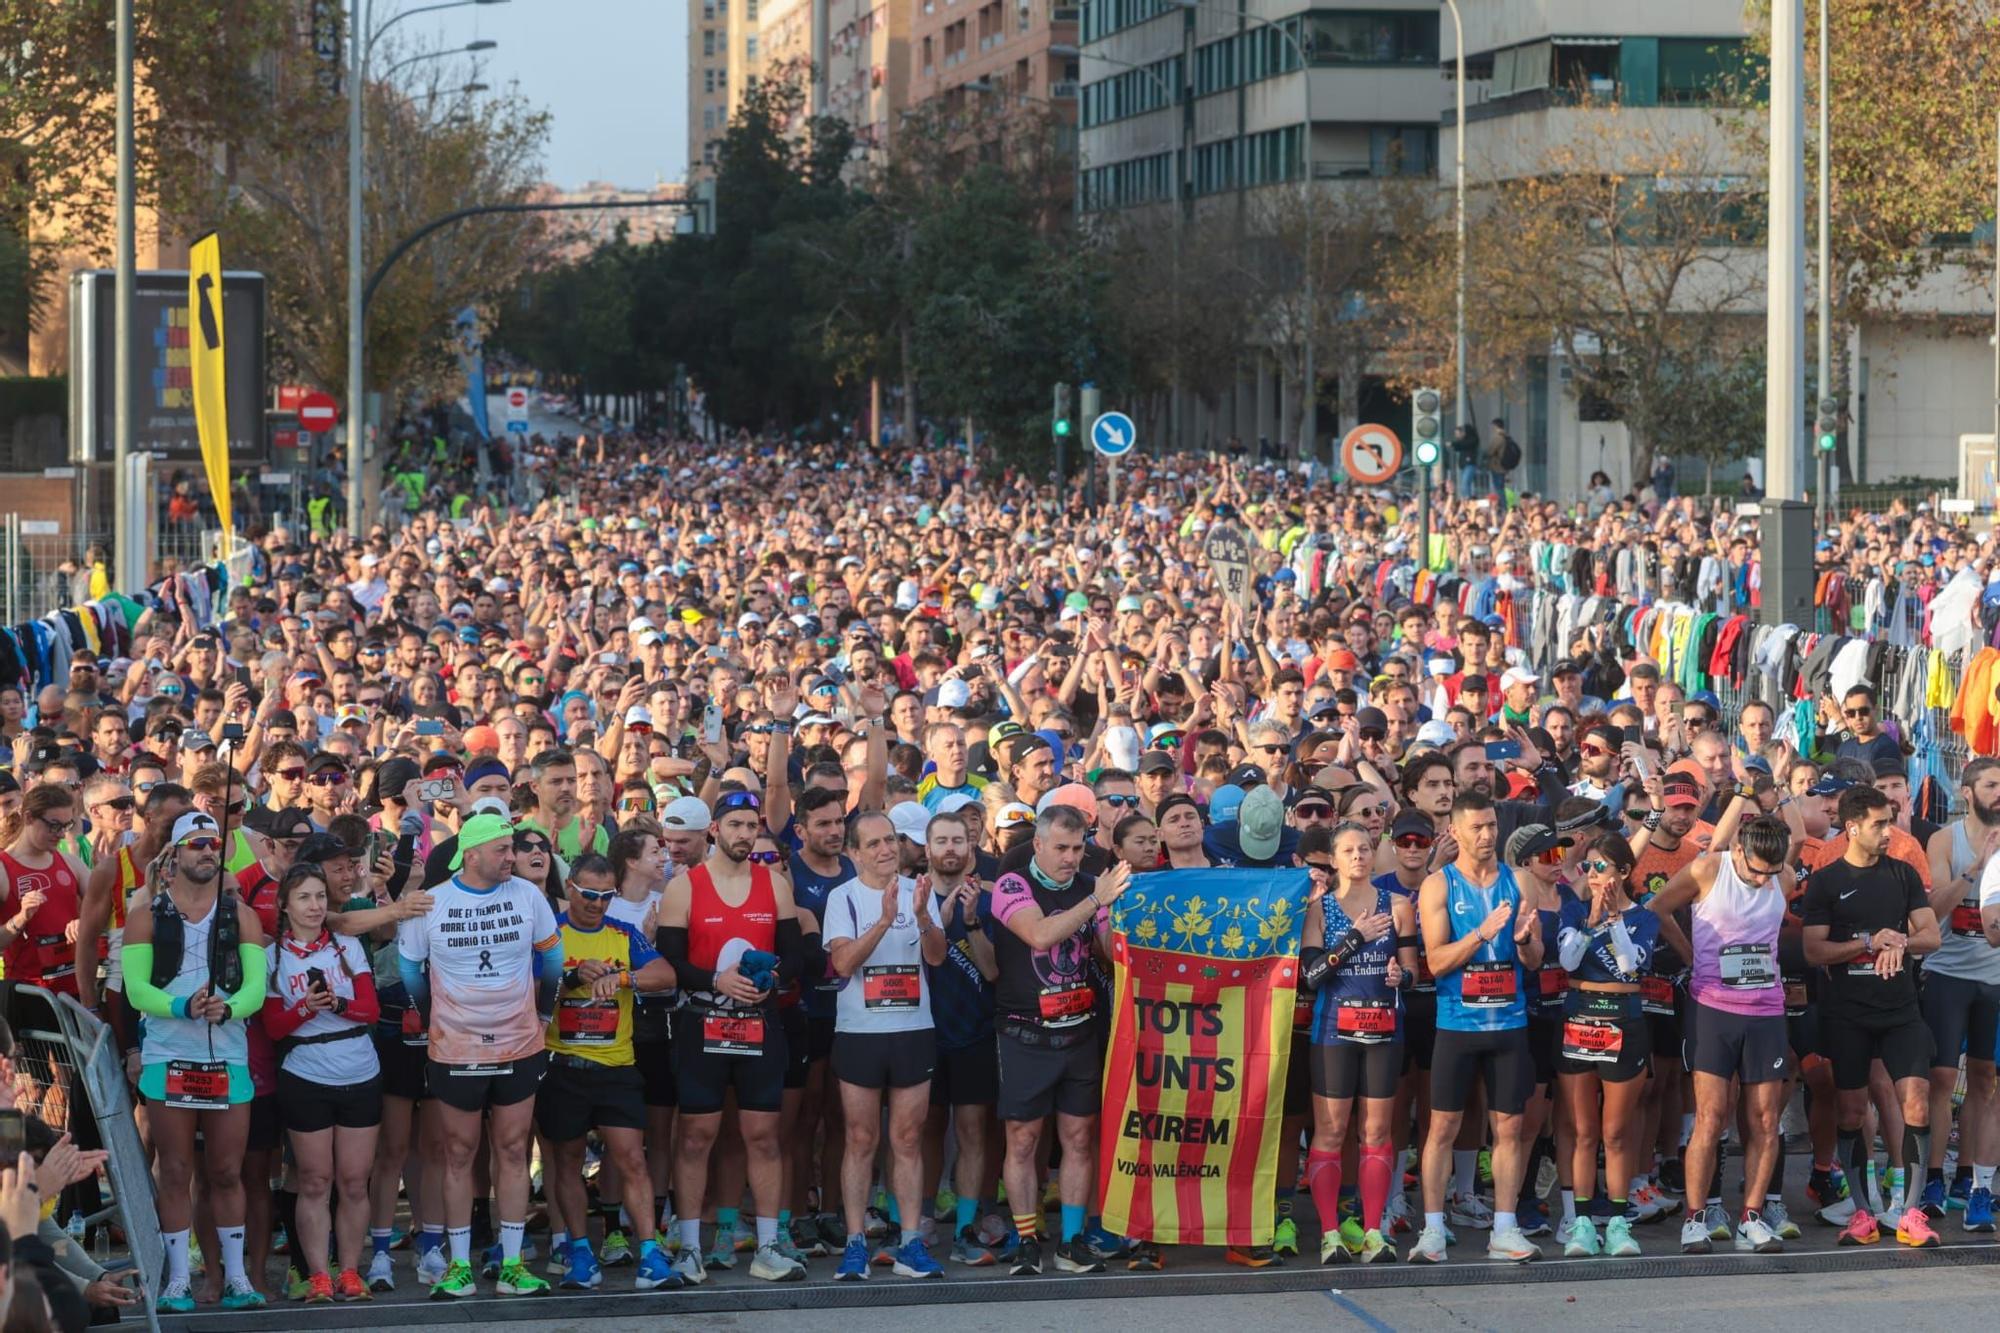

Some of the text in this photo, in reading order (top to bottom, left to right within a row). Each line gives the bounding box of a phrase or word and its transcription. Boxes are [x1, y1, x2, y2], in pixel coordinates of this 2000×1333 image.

[448, 908, 463, 919] QUE
[475, 903, 502, 918] TIEMPO
[503, 901, 514, 911] NO
[440, 922, 466, 933] BORRE
[468, 921, 479, 932] LO
[480, 920, 497, 931] QUE
[498, 917, 510, 928] UN
[481, 936, 491, 945] EL
[493, 931, 520, 944] BARRO
[1133, 997, 1223, 1036] TOTS
[1136, 1051, 1235, 1092] UNTS
[1123, 1110, 1230, 1145] EXIREM
[1153, 1161, 1220, 1177] VALÈNCIA
